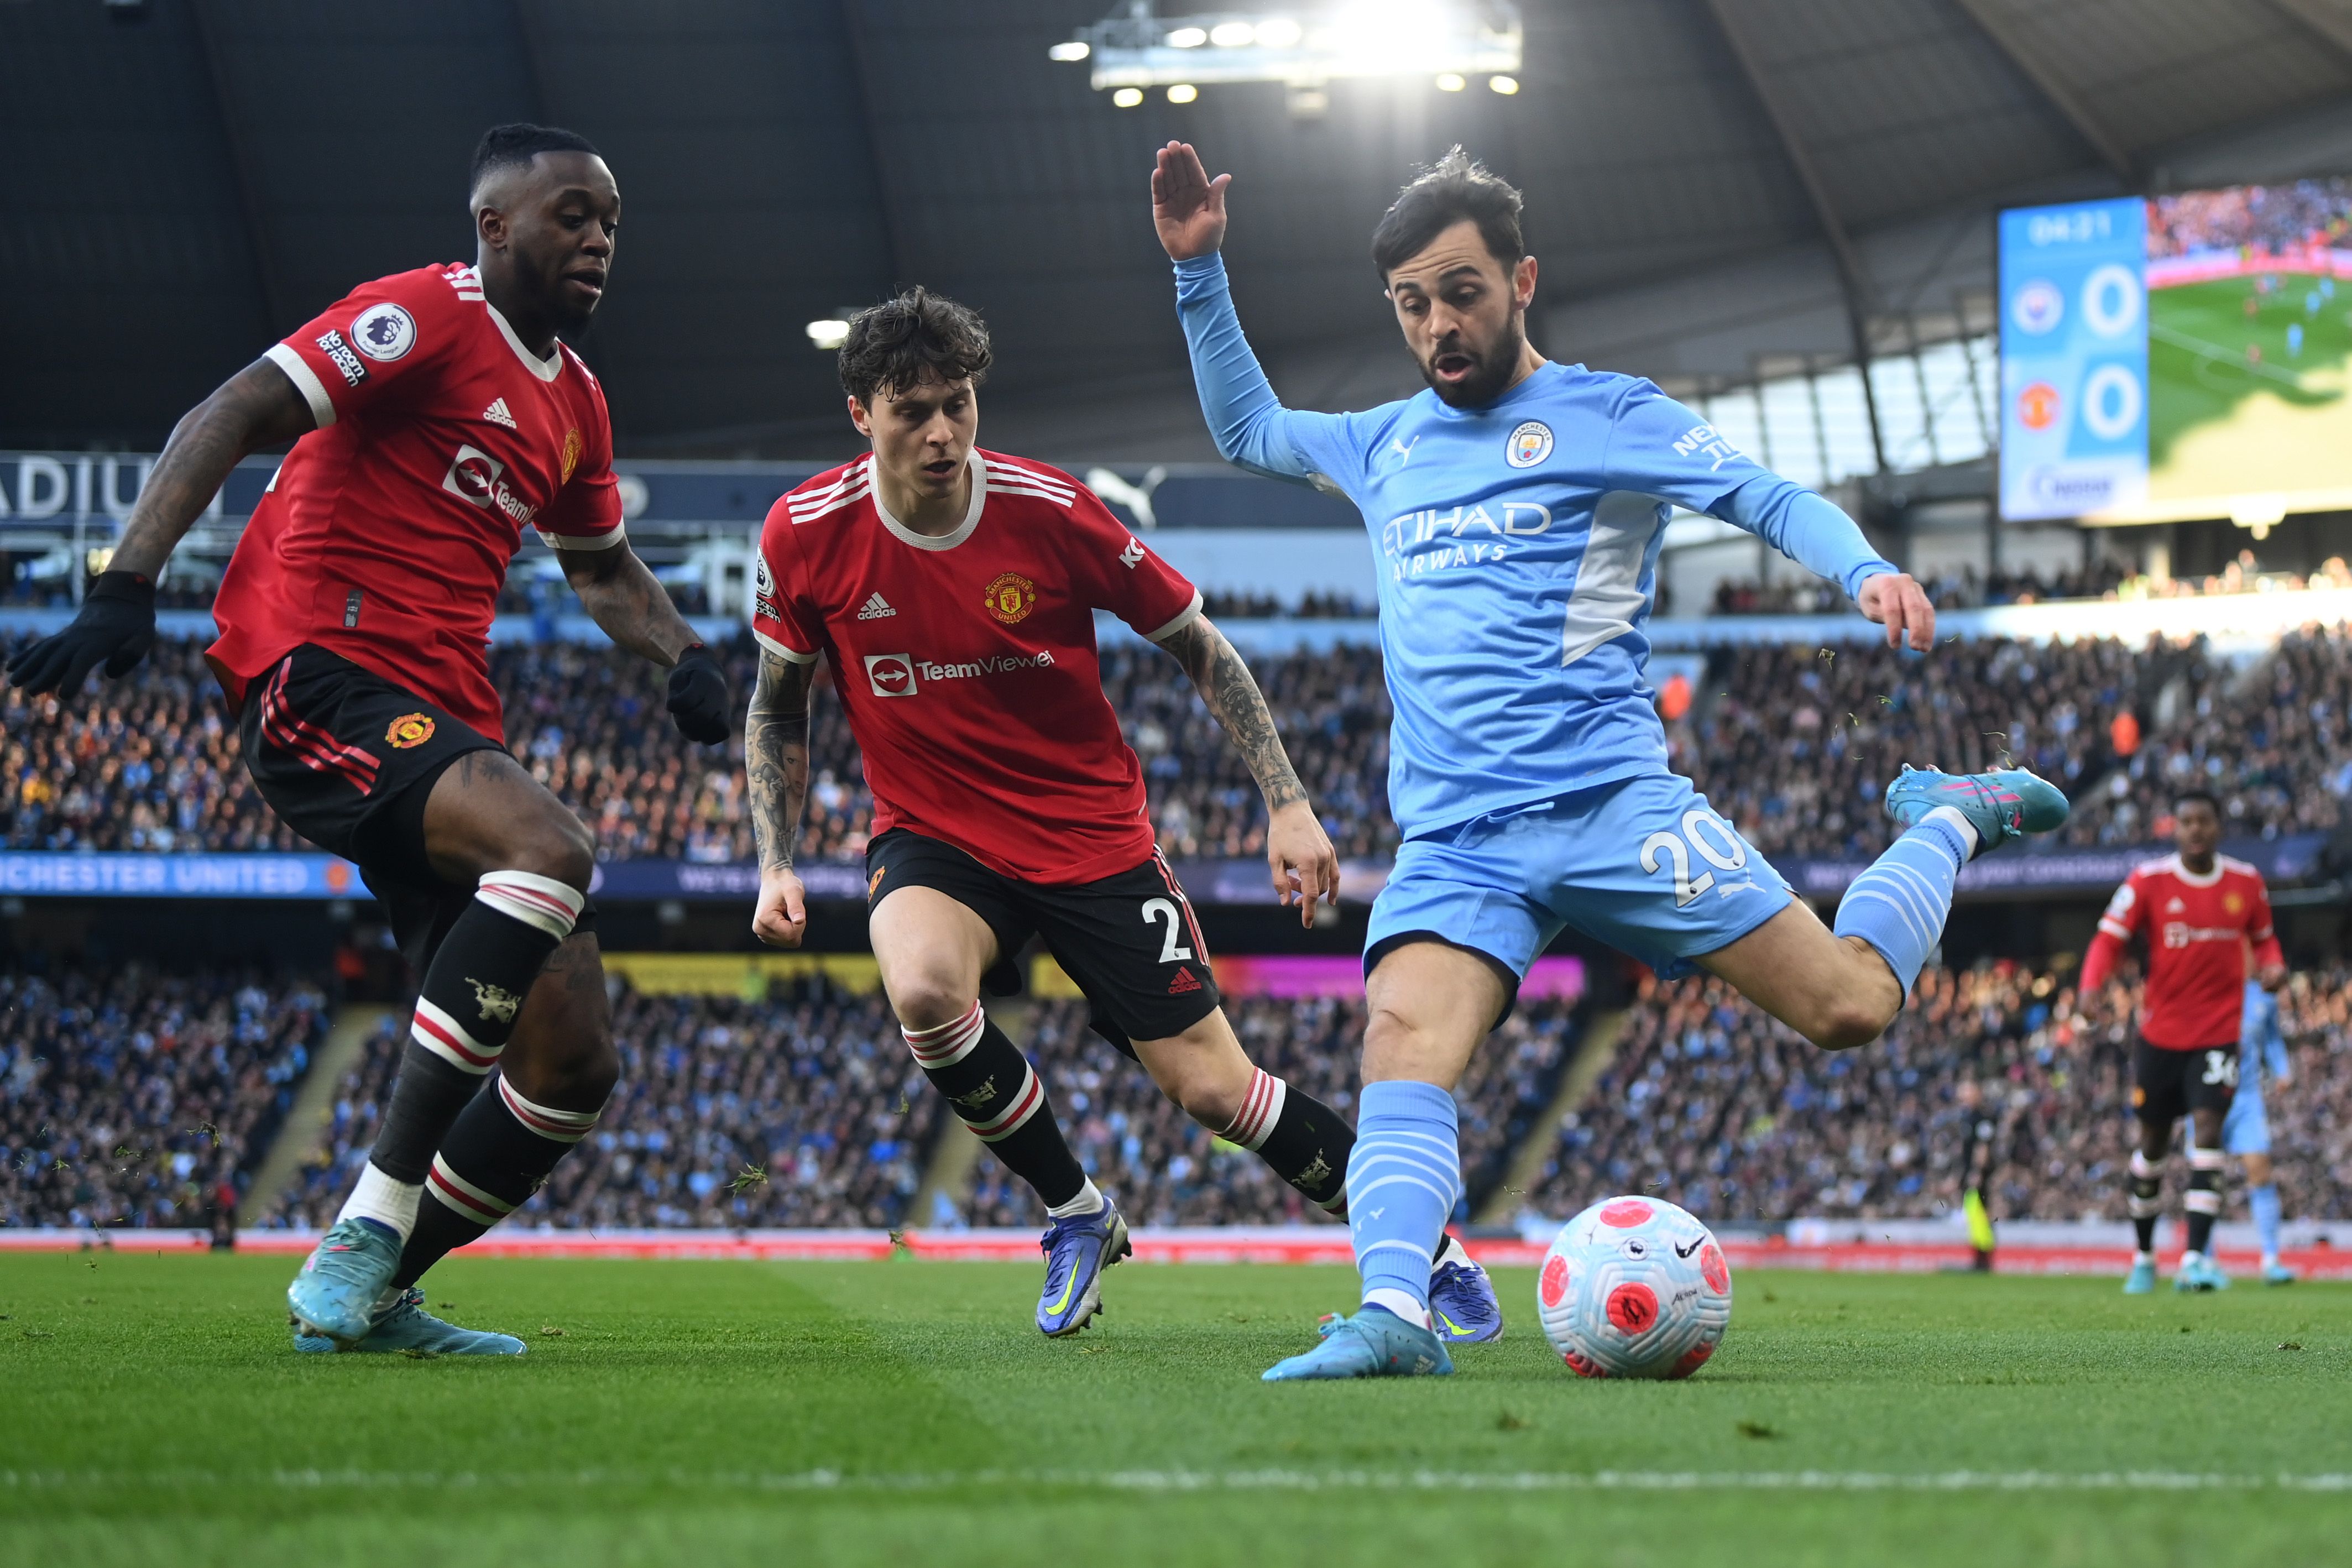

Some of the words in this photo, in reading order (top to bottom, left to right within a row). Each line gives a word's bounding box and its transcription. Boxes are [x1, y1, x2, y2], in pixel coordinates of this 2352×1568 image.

[2081, 264, 2141, 339] 0
[316, 335, 334, 352] for
[328, 349, 359, 387] racism
[325, 330, 342, 347] No
[338, 345, 365, 377] room
[380, 346, 399, 355] League
[483, 411, 517, 429] adidas
[2082, 364, 2142, 440] 0
[1383, 502, 1551, 557] ETIHAD
[1393, 543, 1508, 584] AIRWAYS
[989, 576, 1030, 595] MANCHESTER
[857, 608, 897, 620] adidas
[998, 610, 1027, 620] UNITED
[916, 650, 1055, 681] TeamViewer
[173, 858, 309, 894] UNITED
[1639, 809, 1747, 908] 20
[1142, 897, 1192, 963] 2
[1168, 981, 1203, 994] adidas
